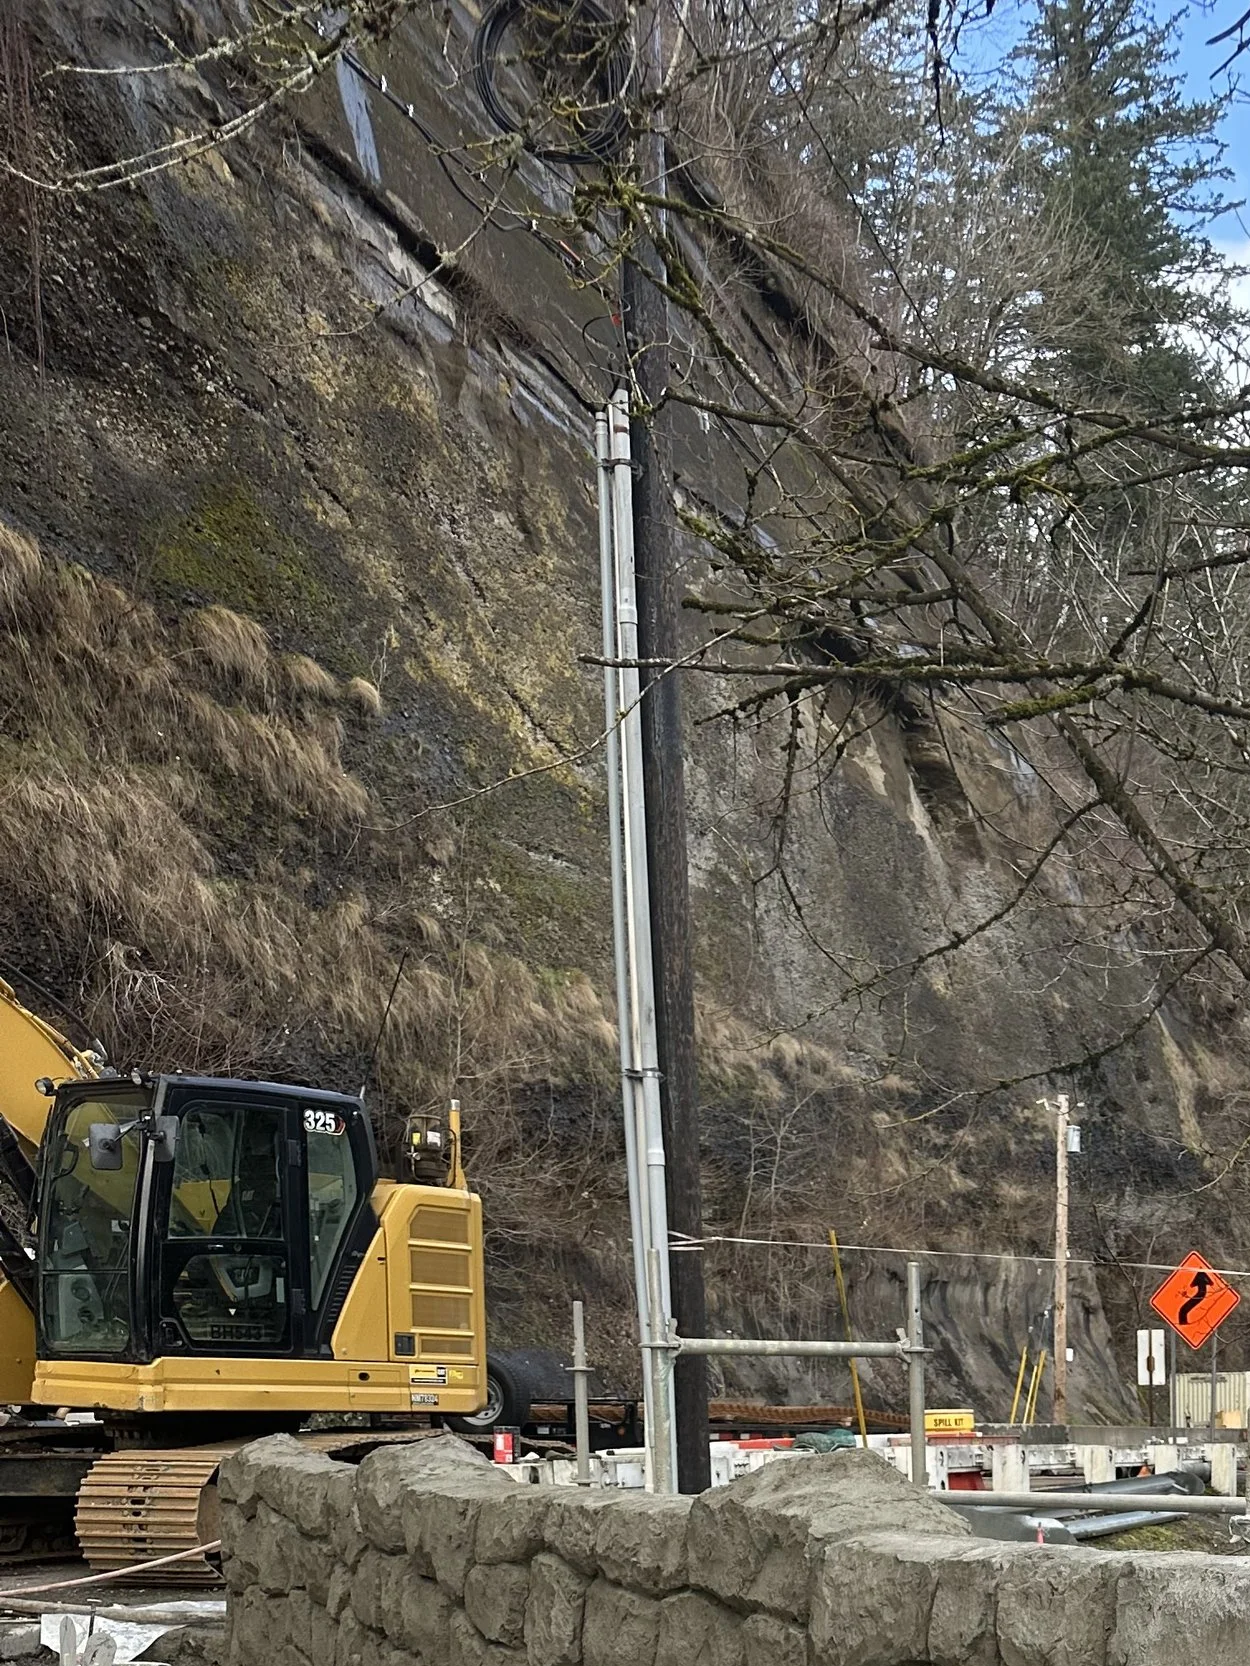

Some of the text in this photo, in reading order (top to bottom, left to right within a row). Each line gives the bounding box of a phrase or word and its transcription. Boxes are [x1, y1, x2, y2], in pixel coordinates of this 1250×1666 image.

[304, 1109, 336, 1132] 325
[933, 1418, 964, 1427] SPILL KIT
